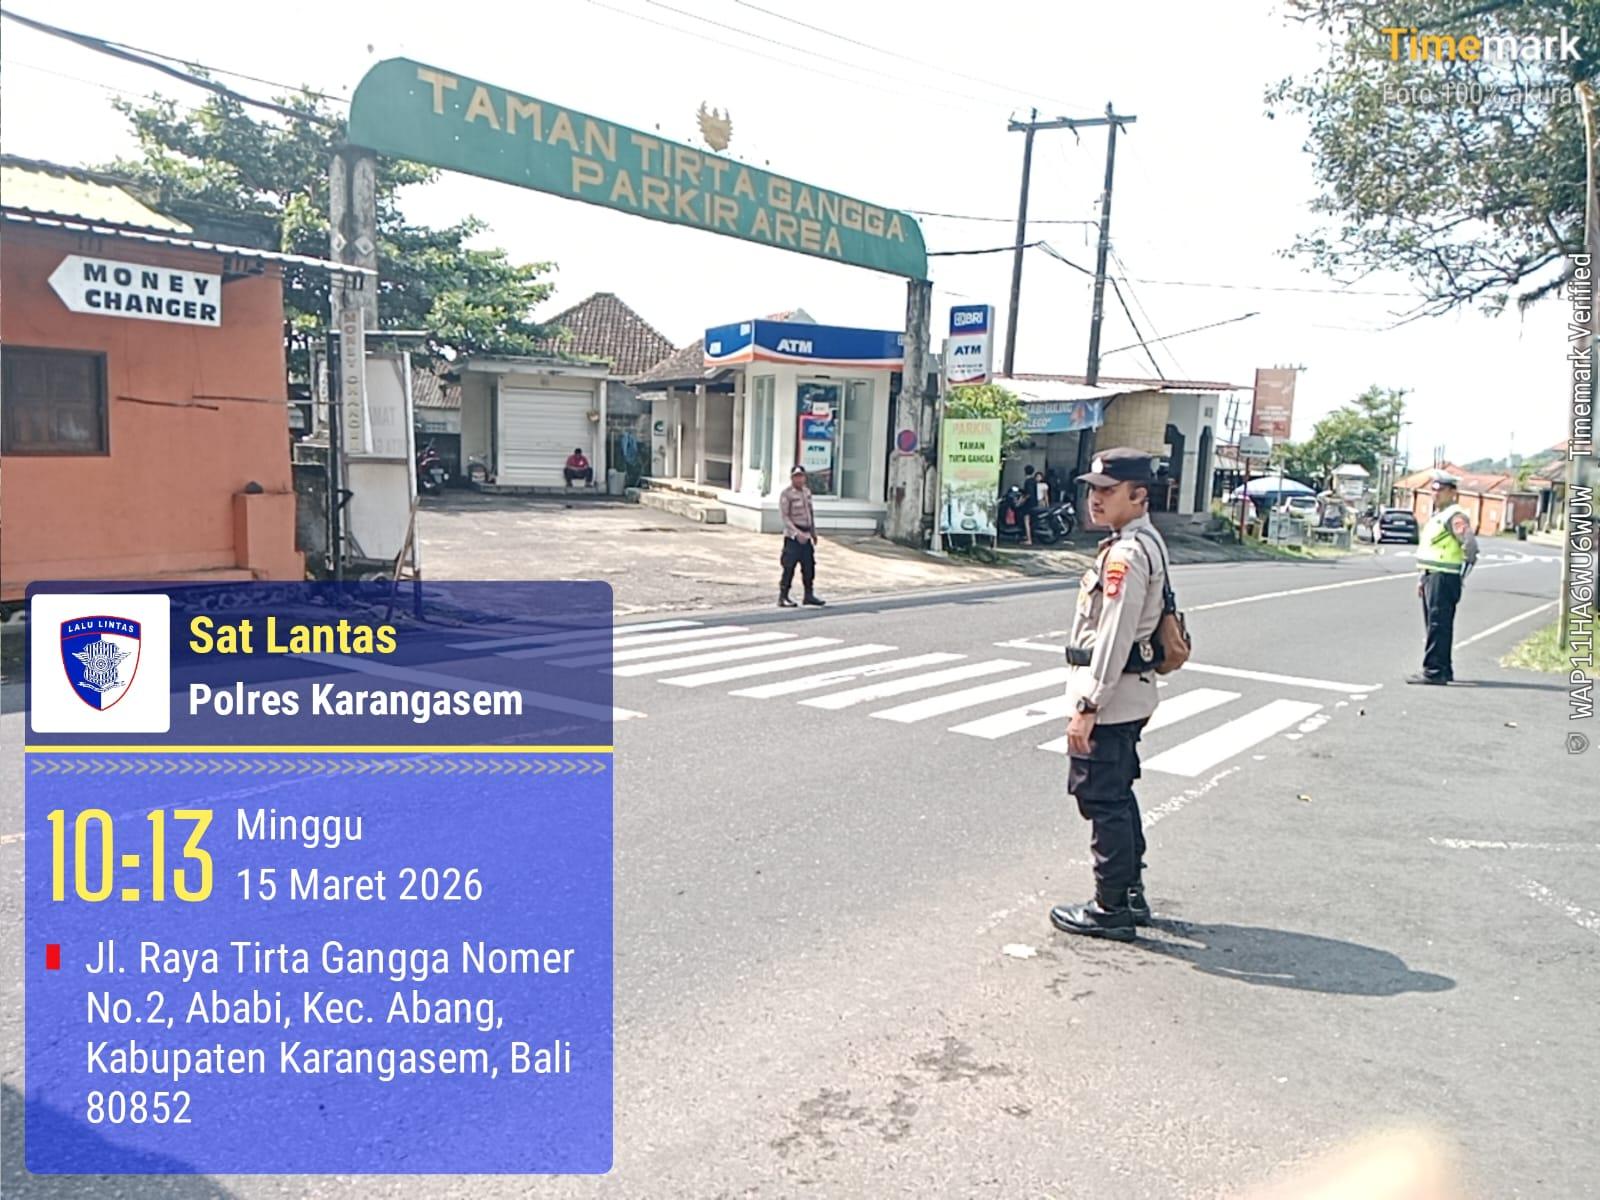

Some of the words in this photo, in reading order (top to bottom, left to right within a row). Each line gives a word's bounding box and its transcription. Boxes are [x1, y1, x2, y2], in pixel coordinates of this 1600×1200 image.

[417, 68, 616, 161] TAMAN
[630, 134, 755, 201] TIRTA
[767, 175, 905, 243] GANGGA
[571, 156, 740, 231] PARKIR
[751, 210, 843, 257] AREA
[82, 261, 211, 297] MONEY
[85, 288, 218, 323] CHANGER
[963, 311, 984, 325] BRI
[343, 314, 358, 369] MONEY
[776, 338, 813, 354] ATM
[953, 344, 982, 356] ATM
[952, 421, 993, 435] PARKIR
[958, 441, 986, 450] TAMAN
[948, 454, 966, 464] TIRTA
[967, 454, 994, 464] GANGGA
